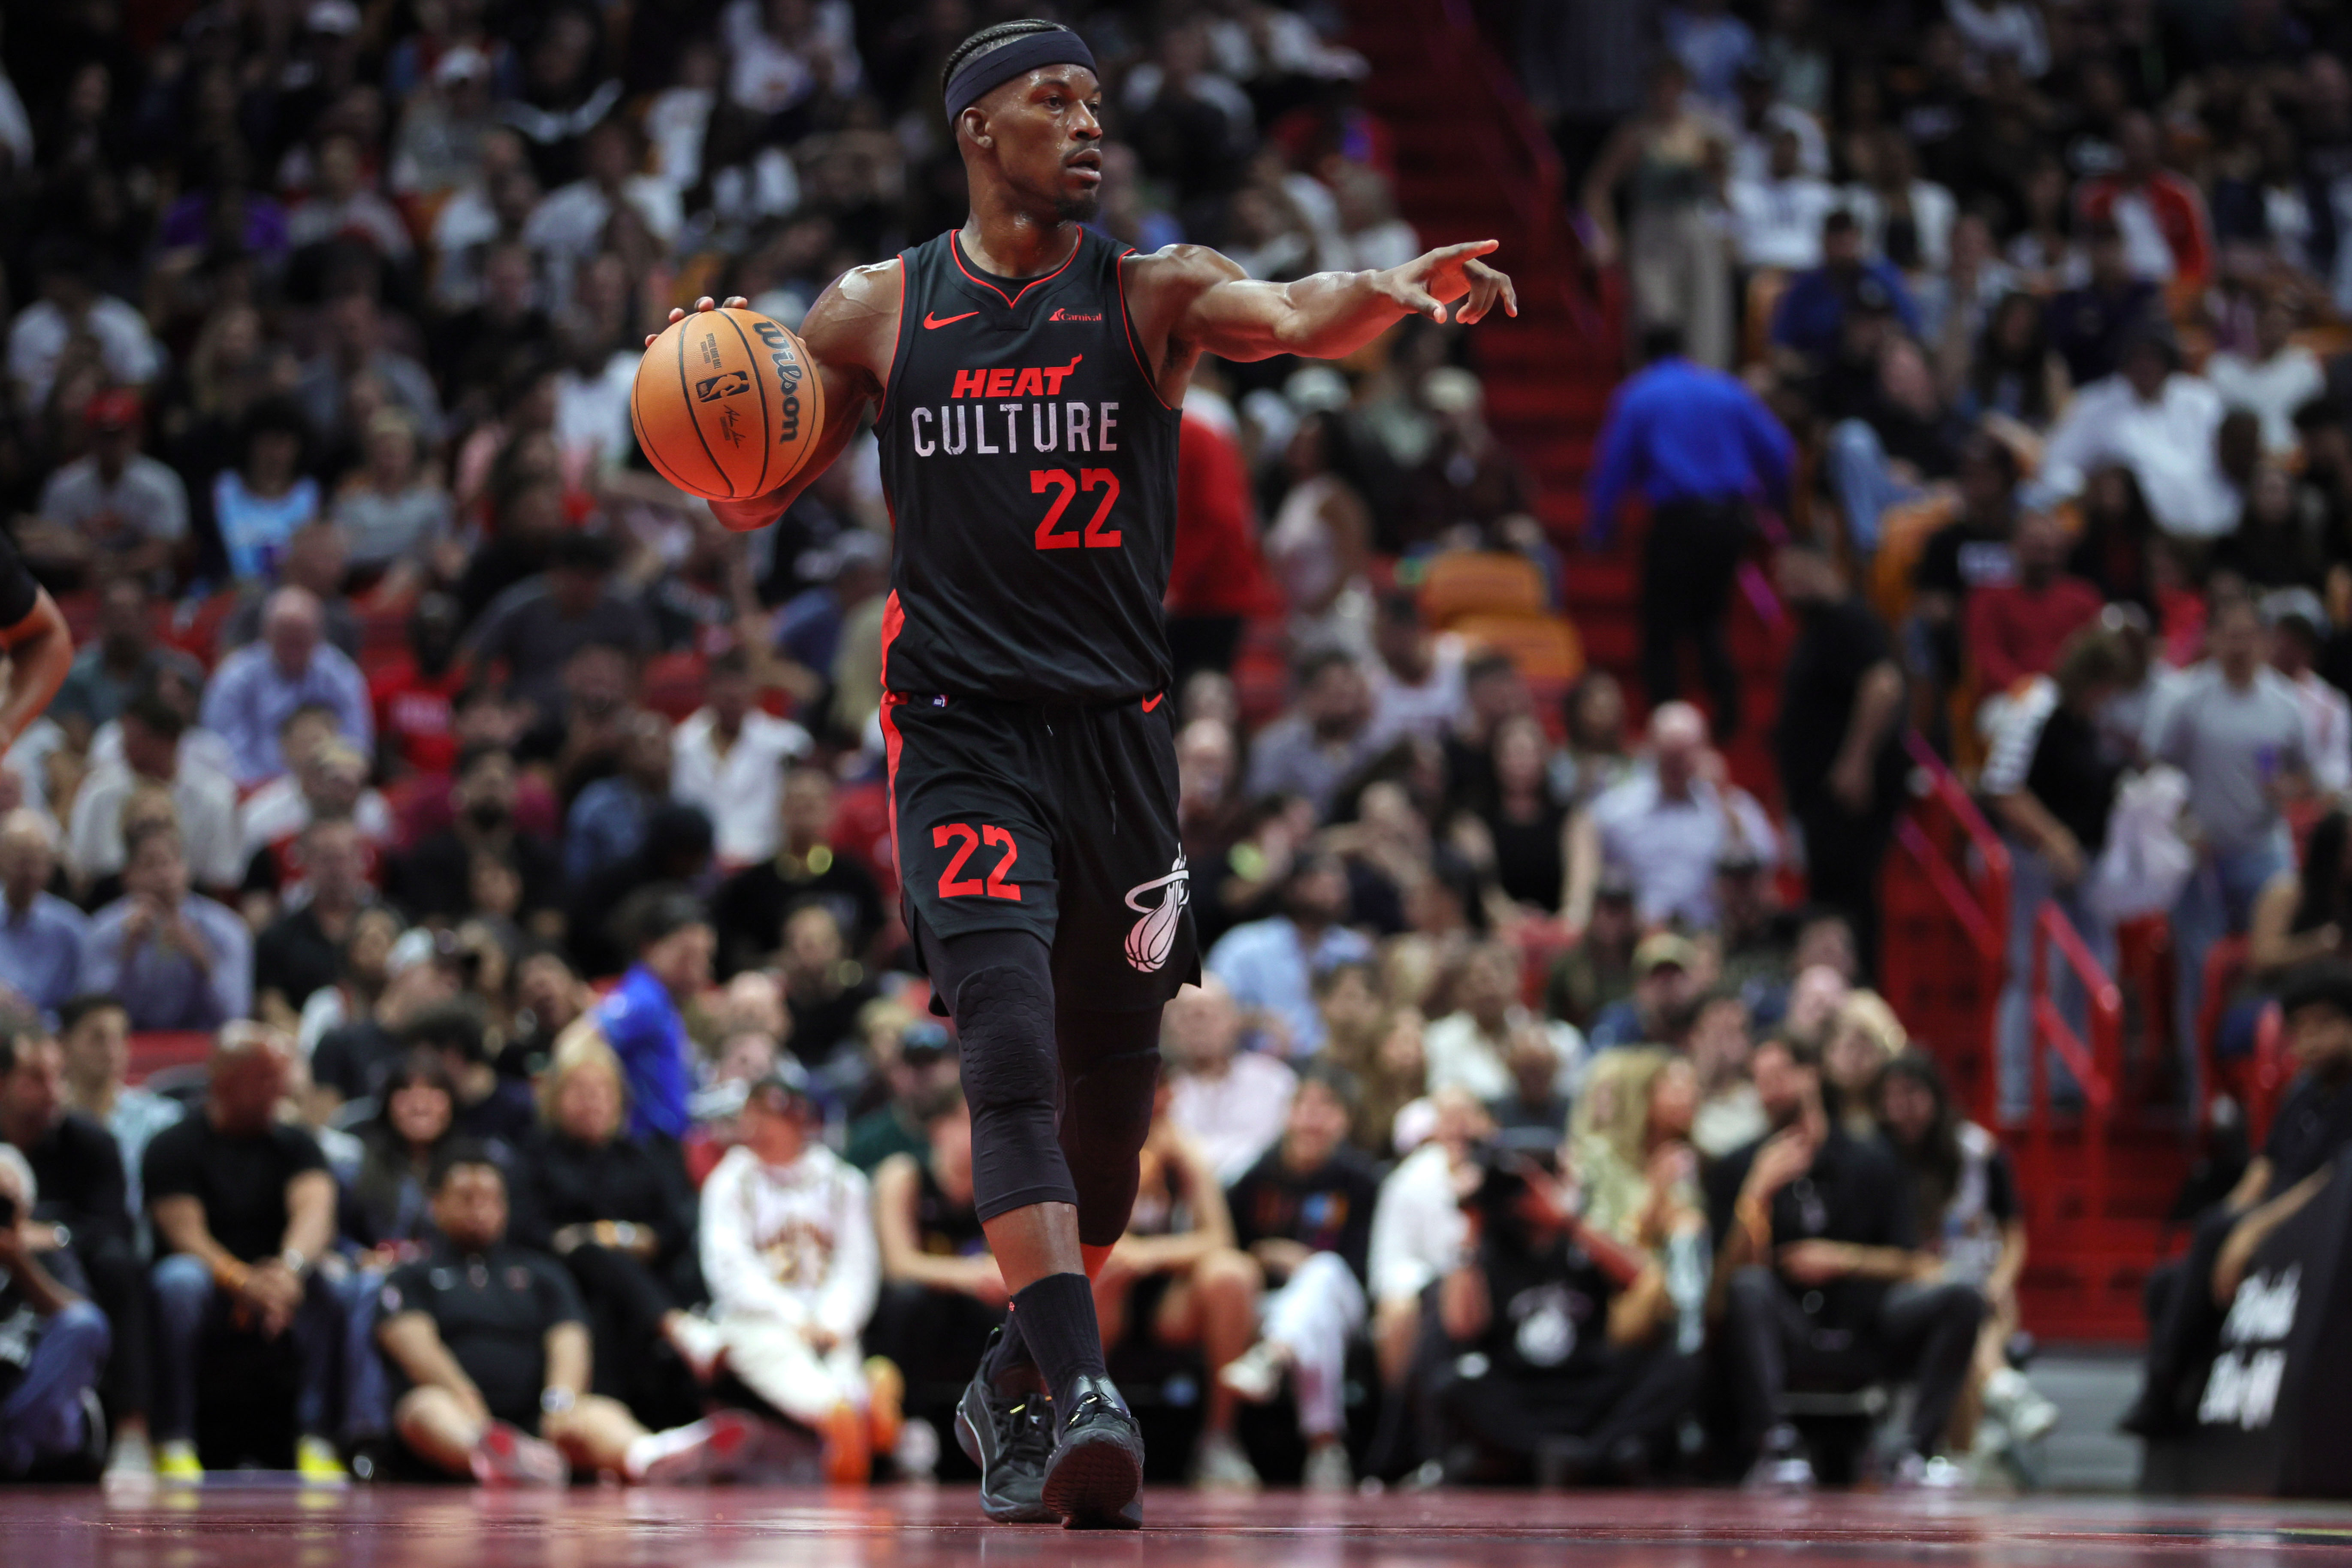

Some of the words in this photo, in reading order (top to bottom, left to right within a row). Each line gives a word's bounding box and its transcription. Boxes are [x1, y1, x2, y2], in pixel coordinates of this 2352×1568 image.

[1061, 313, 1101, 321] Carnival
[752, 321, 802, 445] Wilson
[951, 353, 1082, 398] HEAT
[911, 400, 1119, 457] CULTURE
[1030, 468, 1121, 550] 22
[933, 823, 1021, 901] 22
